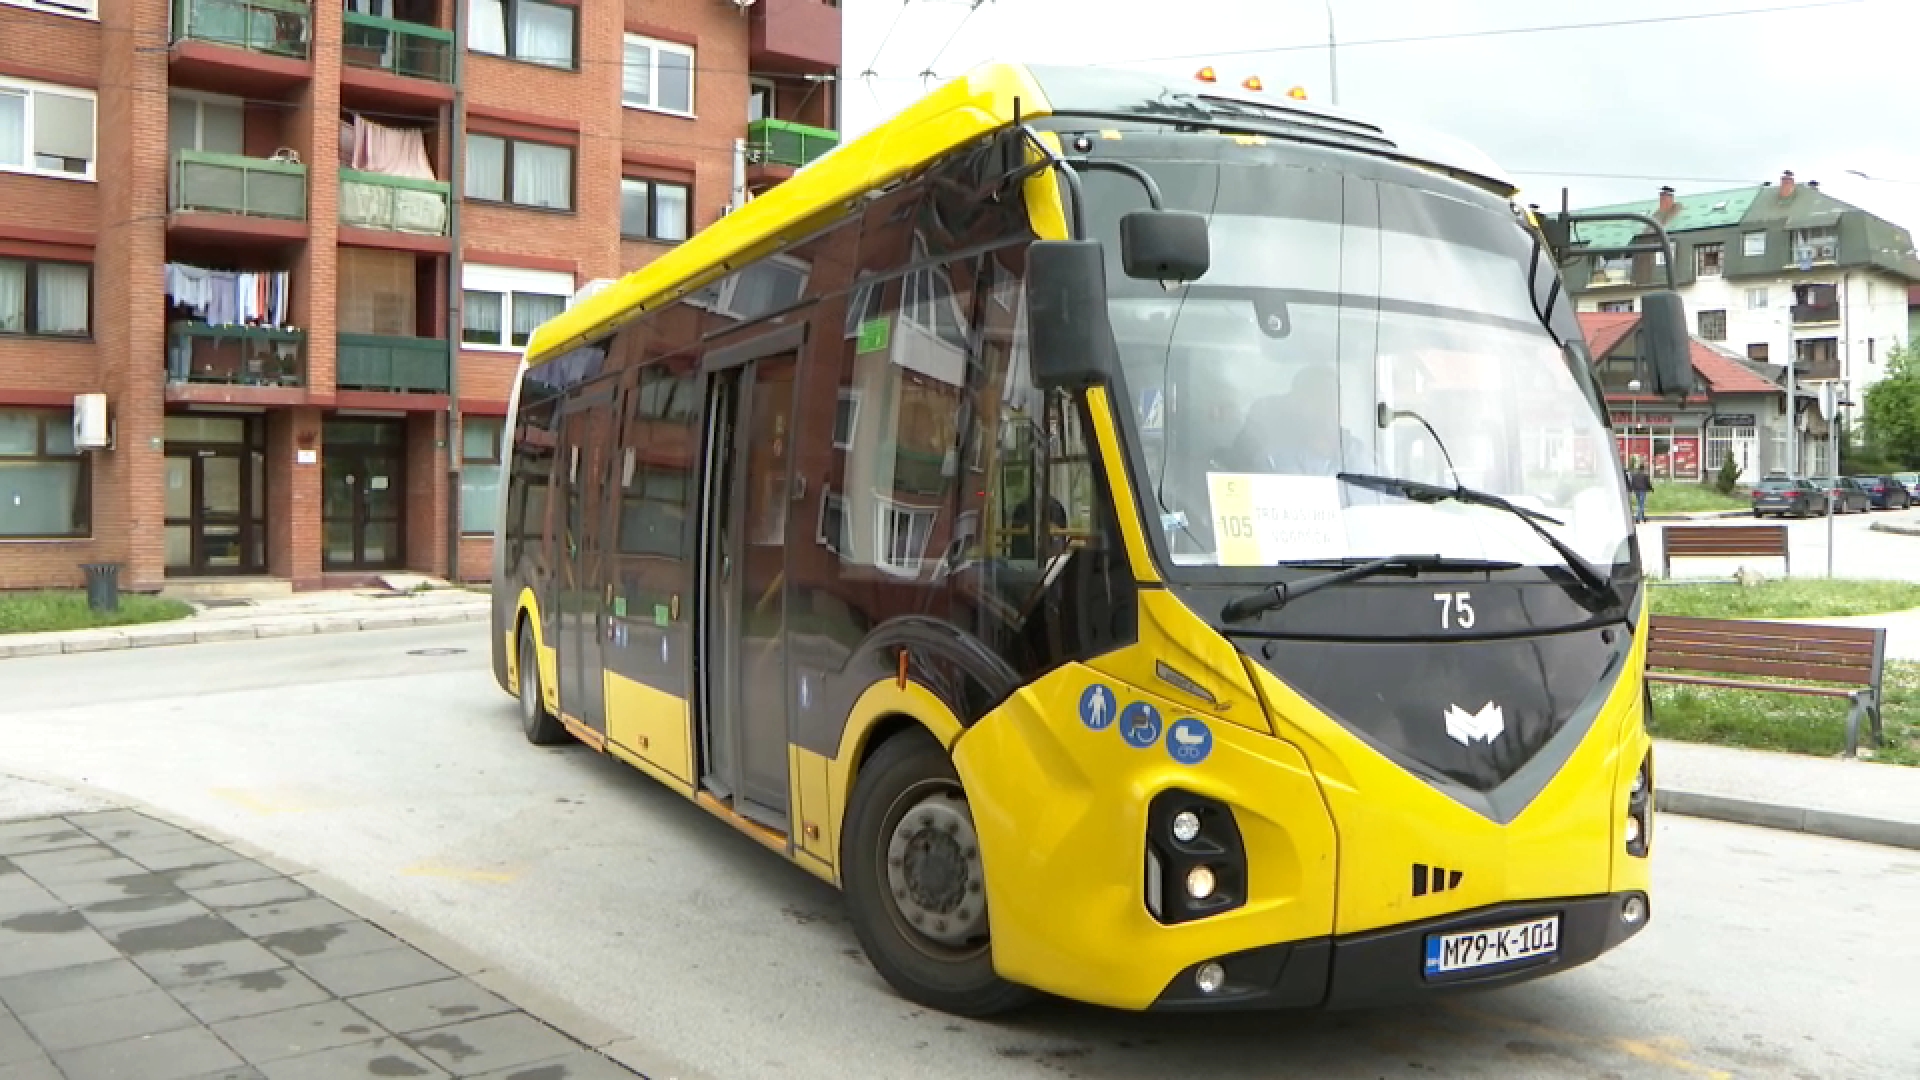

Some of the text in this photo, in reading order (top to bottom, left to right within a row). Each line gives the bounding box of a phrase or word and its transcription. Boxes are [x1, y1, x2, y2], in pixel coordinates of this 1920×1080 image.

[1220, 515, 1253, 538] 105
[1433, 591, 1475, 629] 75
[1443, 921, 1555, 967] M79-K-101
